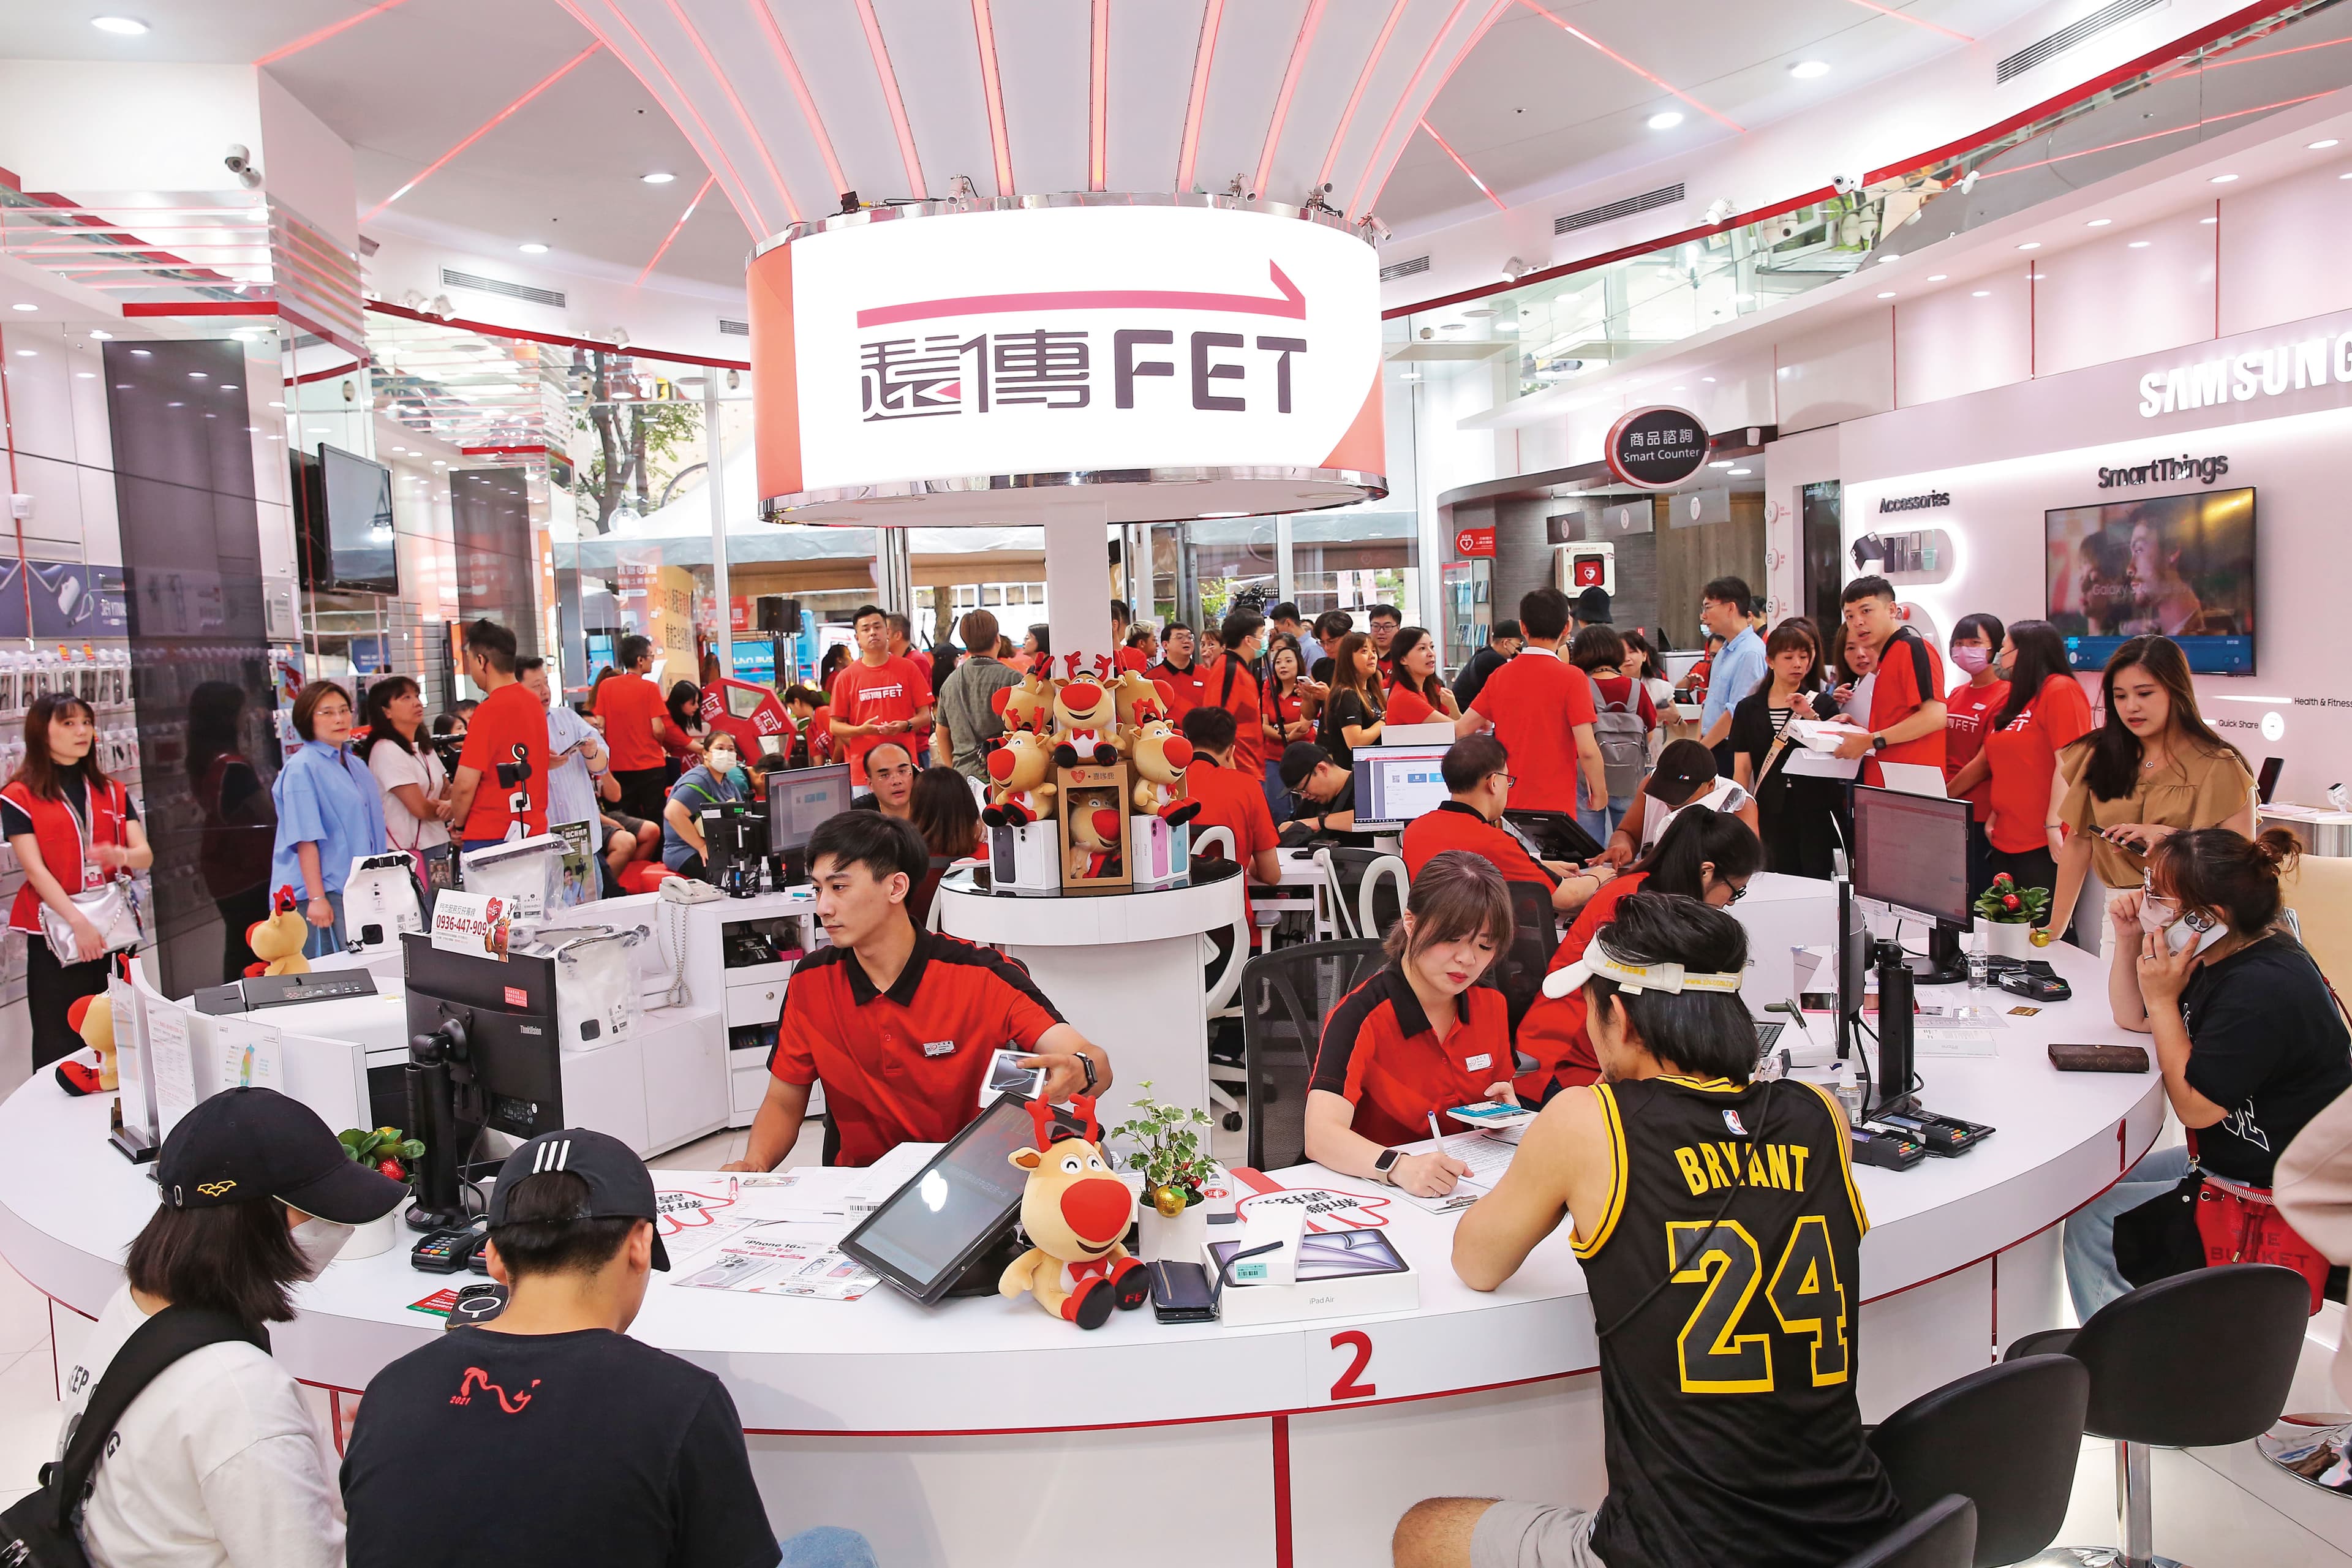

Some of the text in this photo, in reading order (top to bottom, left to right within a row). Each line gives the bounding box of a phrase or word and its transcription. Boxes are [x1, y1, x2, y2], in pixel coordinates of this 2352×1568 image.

[861, 328, 1307, 422] 遠傳 FET
[2138, 332, 2352, 418] SAMSUNG
[1630, 429, 1693, 447] 商品諮詢
[1624, 449, 1700, 462] Smart Counter
[2098, 454, 2228, 489] SmartThings
[1879, 490, 1950, 513] Accessories
[883, 688, 903, 698] FET
[2294, 697, 2319, 706] Health
[1955, 719, 1978, 733] FET
[2004, 719, 2029, 732] ET
[2218, 719, 2259, 729] Quick Share
[436, 914, 487, 936] 0936-447-909
[519, 1024, 542, 1036] ThinkVision
[2117, 1118, 2127, 1172] 1
[1673, 1142, 1809, 1196] BRYANT
[1248, 1191, 1332, 1206] 請找
[1125, 1289, 1147, 1303] FE
[1665, 1215, 1848, 1393] 24
[1330, 1330, 1376, 1401] 2
[450, 1395, 471, 1406] 2021
